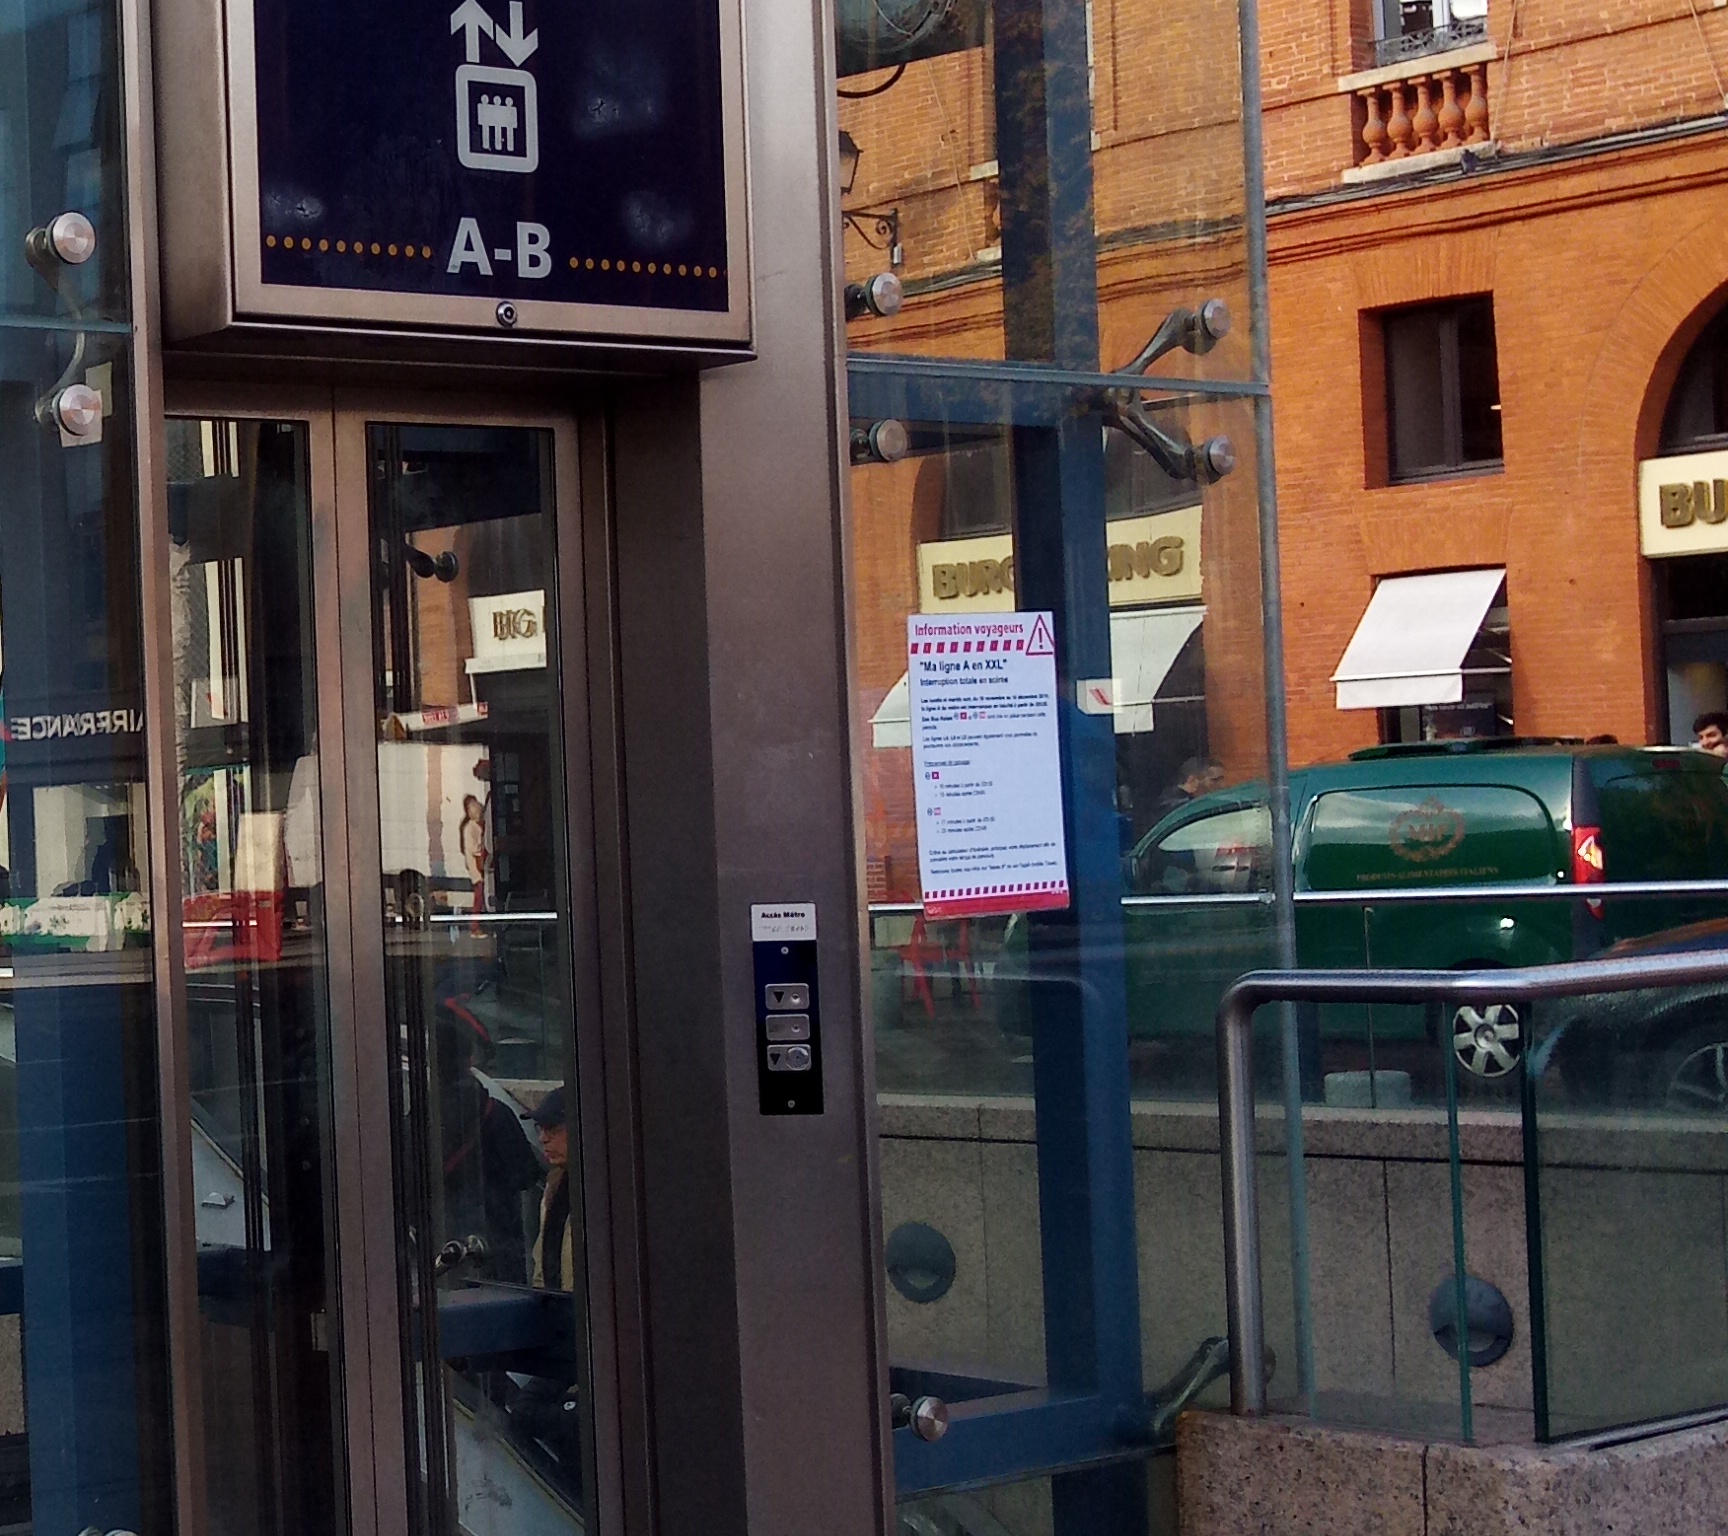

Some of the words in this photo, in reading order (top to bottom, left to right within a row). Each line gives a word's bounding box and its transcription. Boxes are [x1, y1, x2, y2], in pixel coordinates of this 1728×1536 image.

[446, 217, 552, 279] A-B
[1107, 536, 1184, 582] ING
[915, 623, 971, 636] Information
[975, 623, 1024, 637] voyageurs
[939, 661, 961, 674] ligne
[963, 660, 970, 670] A
[972, 662, 983, 670] en
